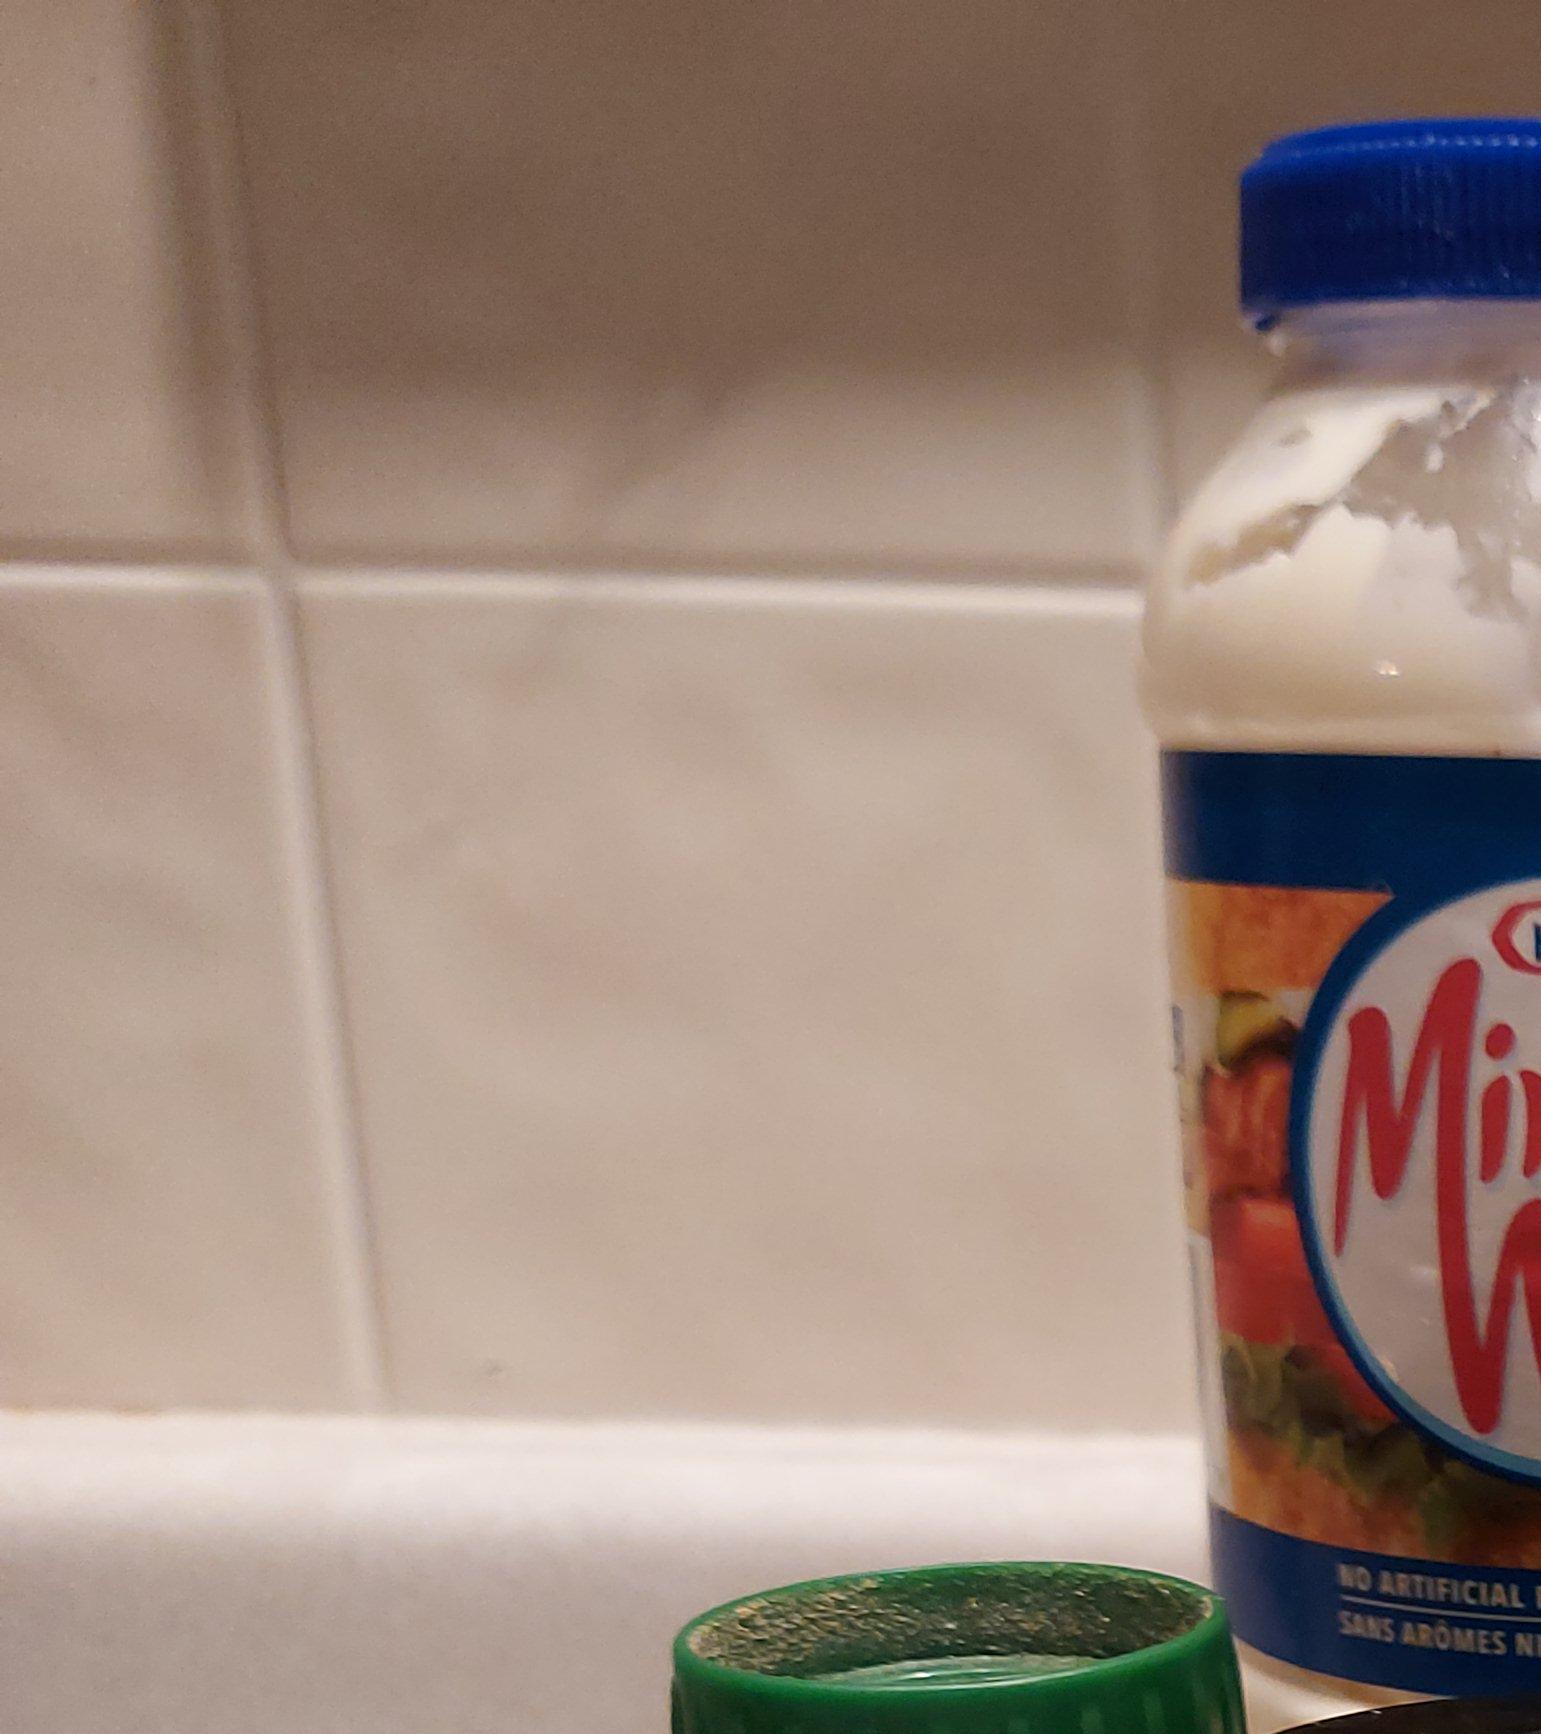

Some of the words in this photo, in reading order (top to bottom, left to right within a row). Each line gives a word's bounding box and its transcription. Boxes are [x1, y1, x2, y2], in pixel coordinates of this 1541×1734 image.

[1336, 1561, 1372, 1592] NO
[1379, 1564, 1525, 1609] ARTIFICIAL
[1337, 1609, 1395, 1643] SANS
[1401, 1618, 1507, 1656] ARÔMES
